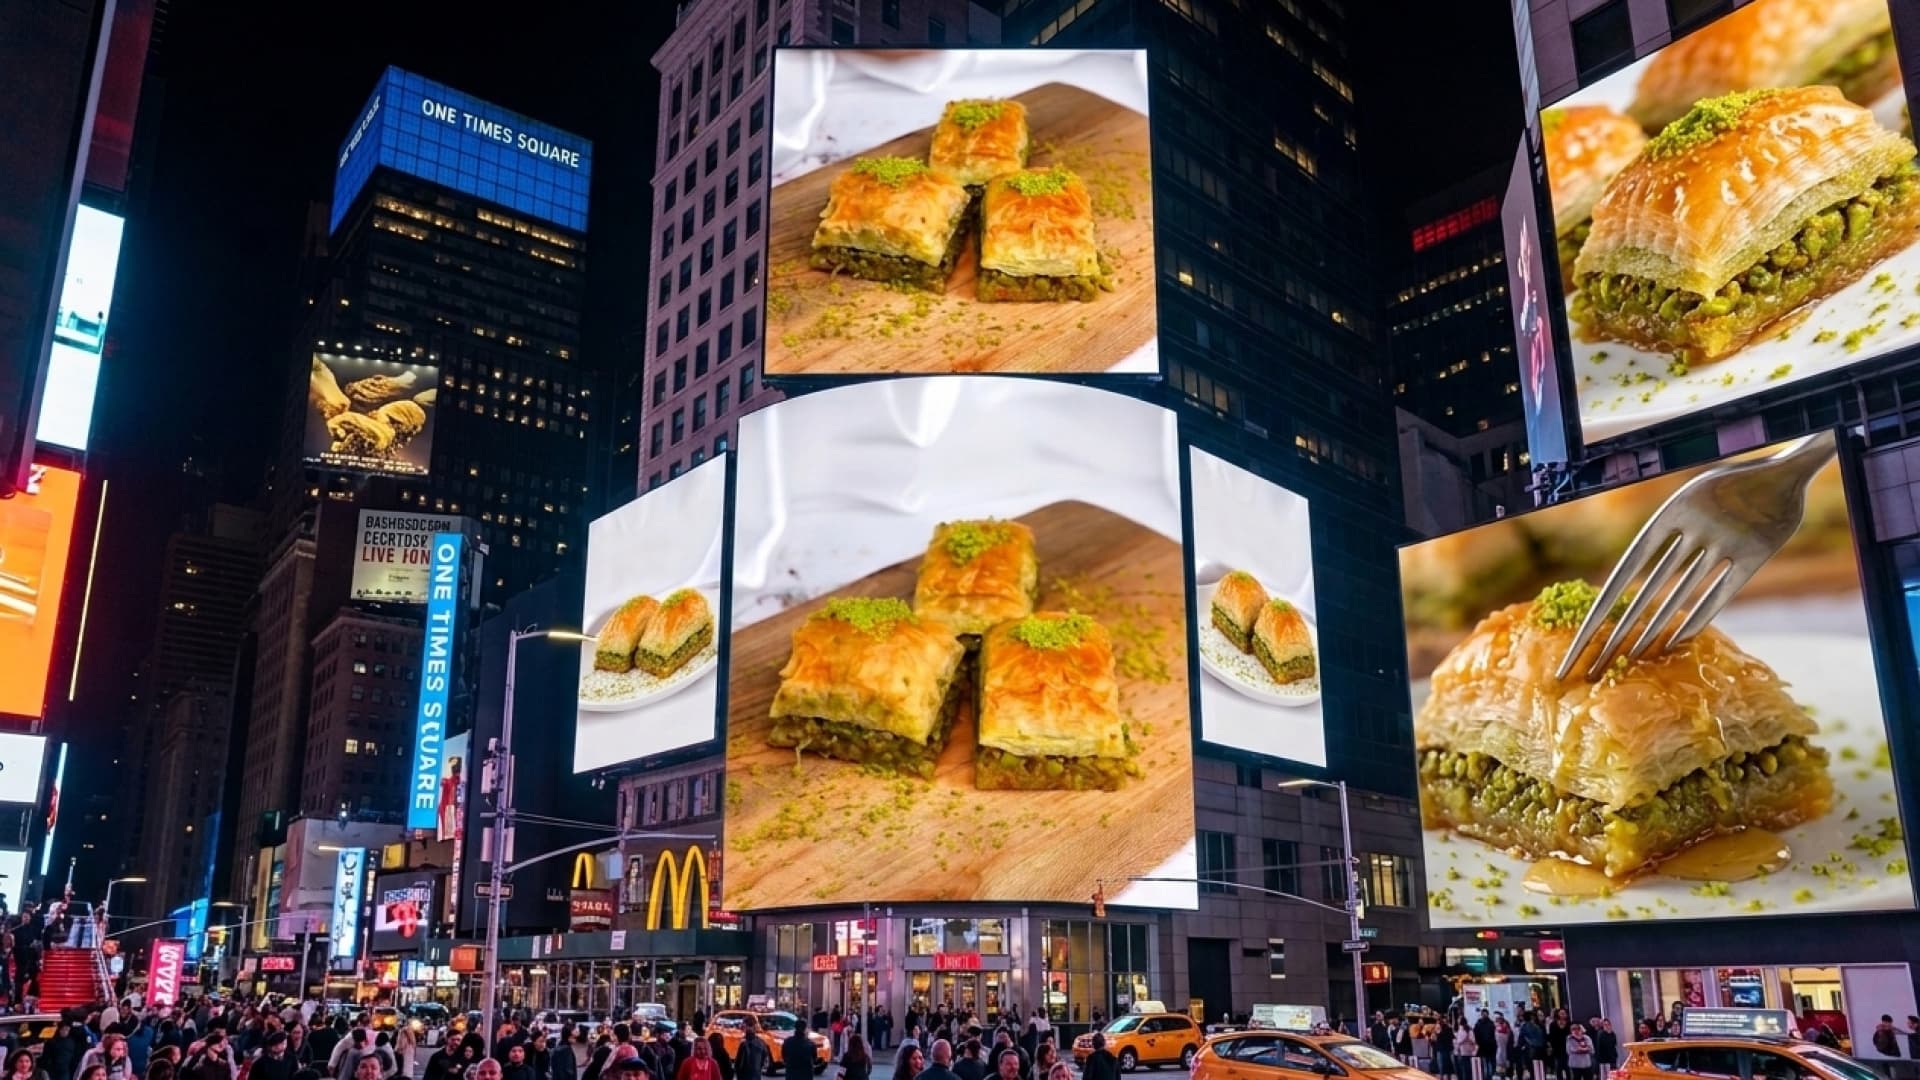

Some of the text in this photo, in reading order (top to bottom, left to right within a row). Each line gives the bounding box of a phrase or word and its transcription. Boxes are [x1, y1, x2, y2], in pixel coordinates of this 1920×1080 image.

[422, 99, 580, 168] ONE TIMES SQUARE
[362, 545, 395, 563] LIVE
[433, 543, 455, 600] ONE
[426, 609, 451, 692] TIMES
